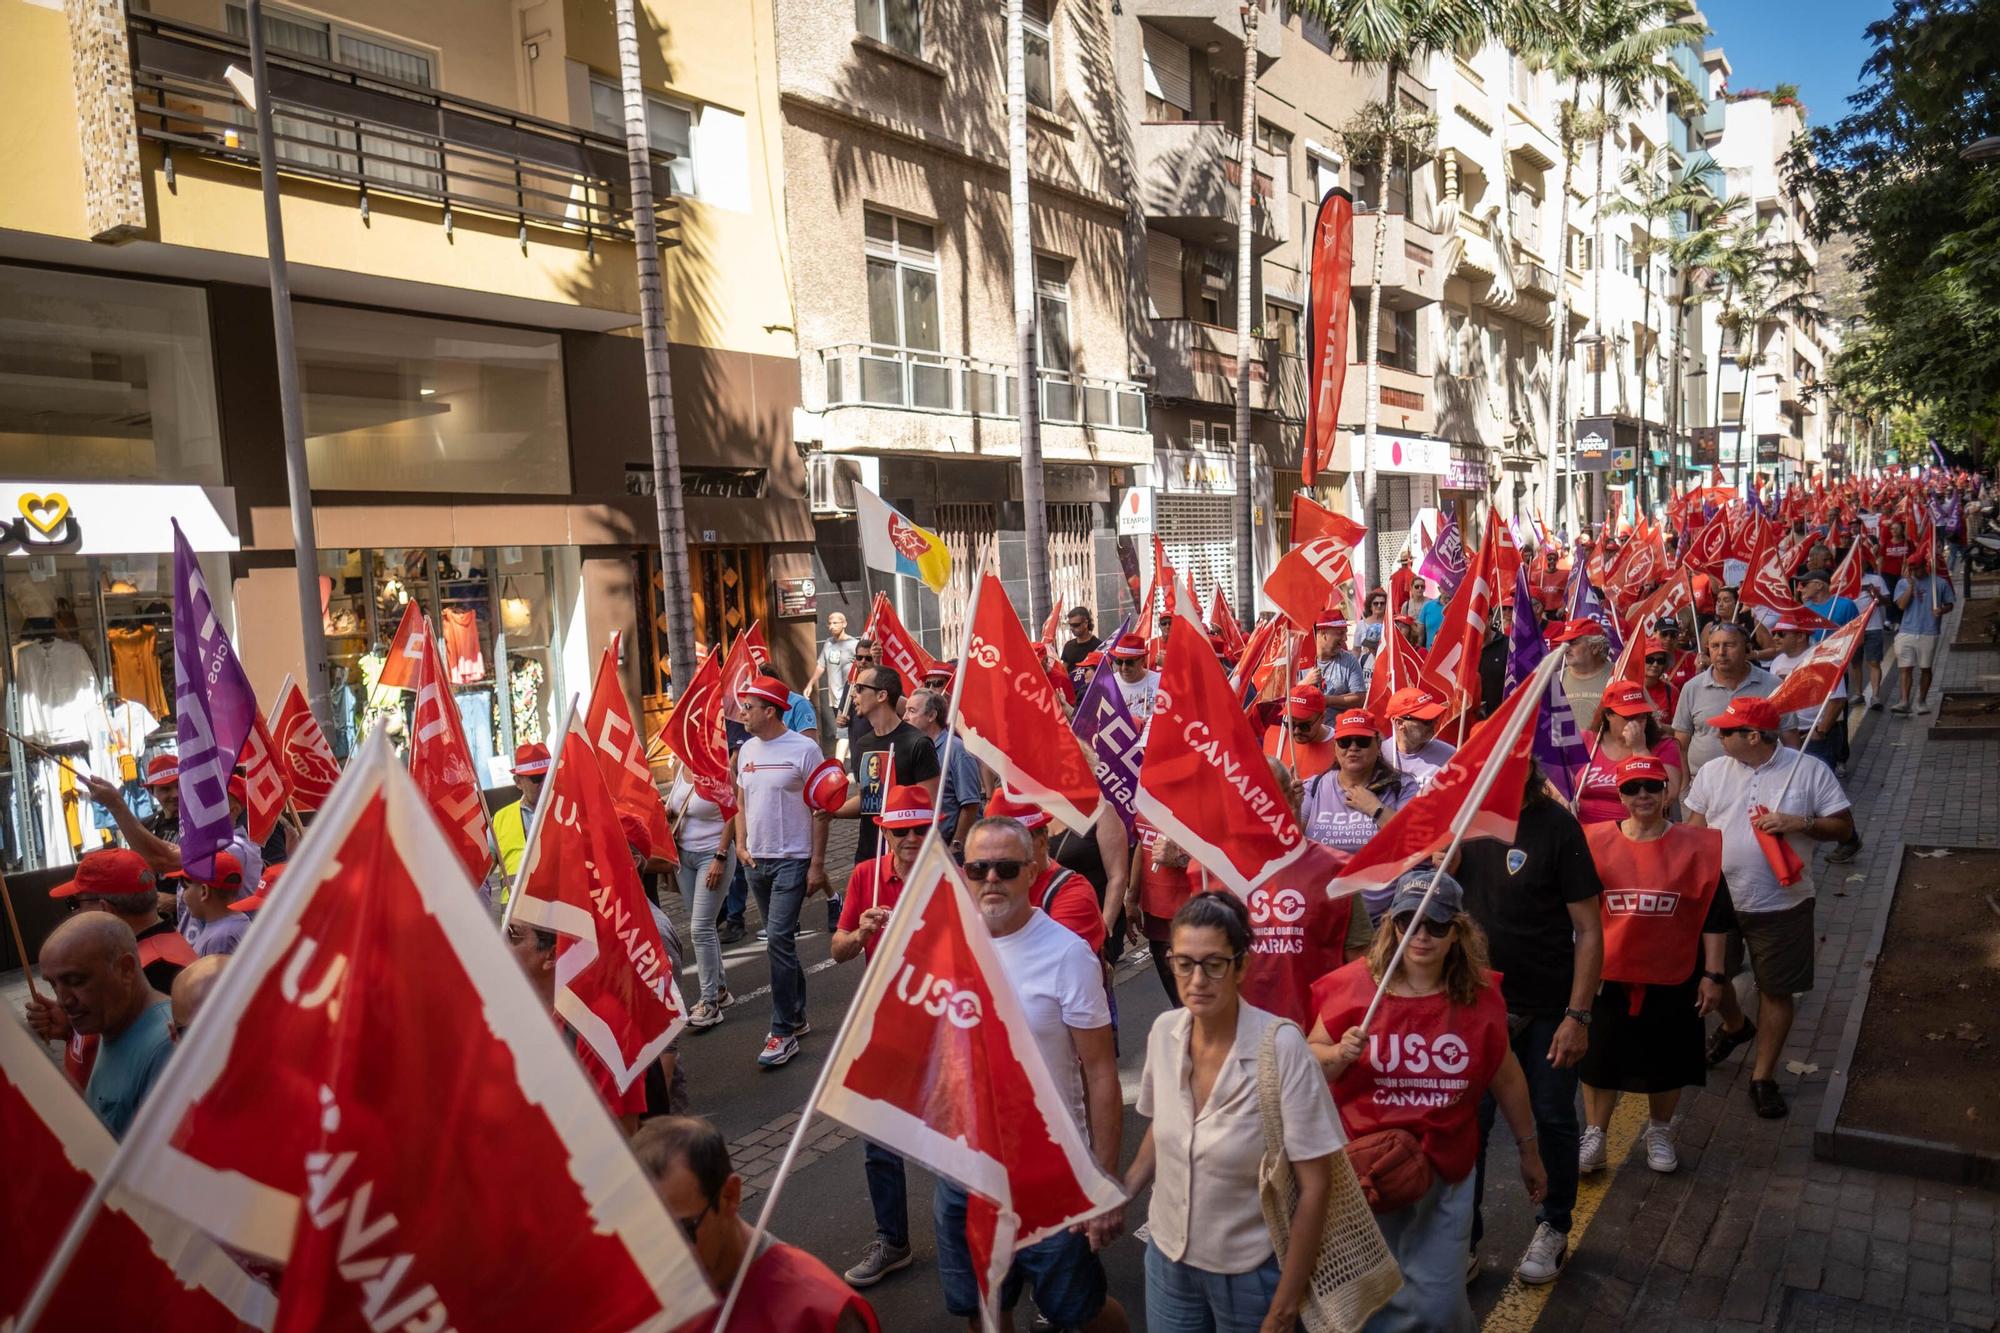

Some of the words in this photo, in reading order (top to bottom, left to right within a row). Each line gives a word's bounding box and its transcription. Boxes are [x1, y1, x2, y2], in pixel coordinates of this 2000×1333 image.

[1623, 692, 1642, 701] CCOO
[1342, 717, 1365, 725] CCOO
[1625, 762, 1651, 771] CCOO
[1184, 721, 1299, 846] CANARIAS
[1321, 837, 1369, 845] Canarias
[1607, 893, 1675, 911] CCOO
[897, 964, 983, 1028] USO
[1369, 1033, 1469, 1074] USO
[1400, 1078, 1438, 1089] SINDICAL
